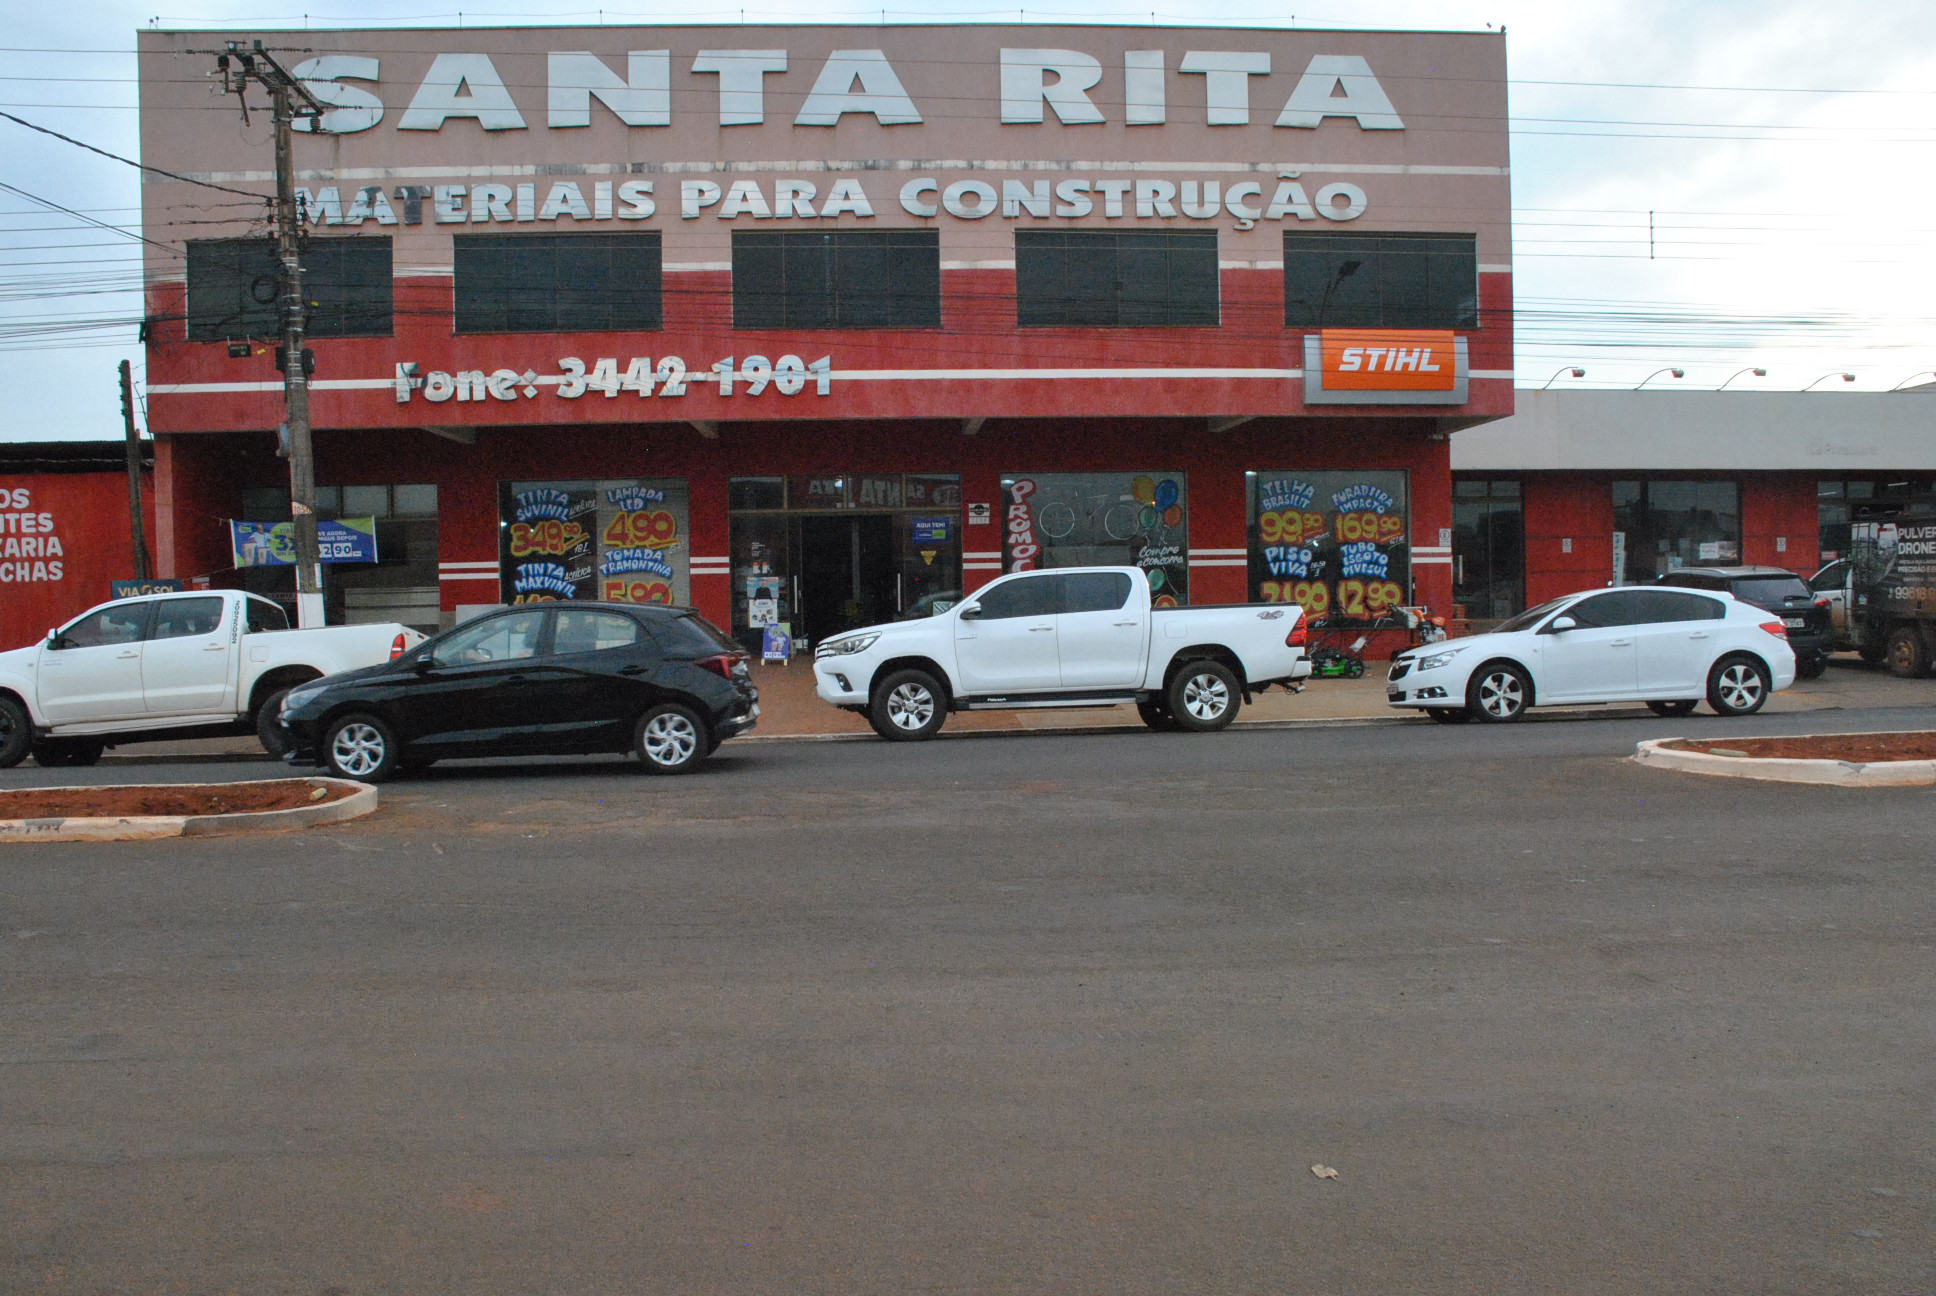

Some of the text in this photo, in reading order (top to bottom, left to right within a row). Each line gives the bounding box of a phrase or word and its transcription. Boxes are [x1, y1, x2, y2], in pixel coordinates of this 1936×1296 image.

[291, 48, 1405, 133] SANTA RITA
[294, 171, 1367, 229] MATERIAIS PARA CONSTRUÇÃO
[1338, 347, 1440, 372] STIHL
[395, 354, 830, 403] Fone: 3442-1901
[1263, 479, 1315, 498] TELHA
[1331, 485, 1393, 508] FURADEIRA
[517, 489, 569, 506] TINTA
[620, 498, 643, 512] LED
[1262, 493, 1312, 510] BRASILIT
[1339, 499, 1386, 513] IMPACTO
[516, 503, 569, 521] SUVINIL
[0, 512, 54, 533] TES
[0, 536, 63, 558] ARIA
[605, 548, 664, 562] TOMADA
[1264, 546, 1312, 562] PISO
[1340, 542, 1375, 555] TUBO
[1342, 552, 1388, 566] ESGOTO
[516, 563, 566, 579] TINTA
[599, 559, 673, 578] TRAMONTINA
[1269, 561, 1308, 577] VIVA
[118, 586, 140, 597] VIA
[514, 576, 577, 599] MAXVINIL
